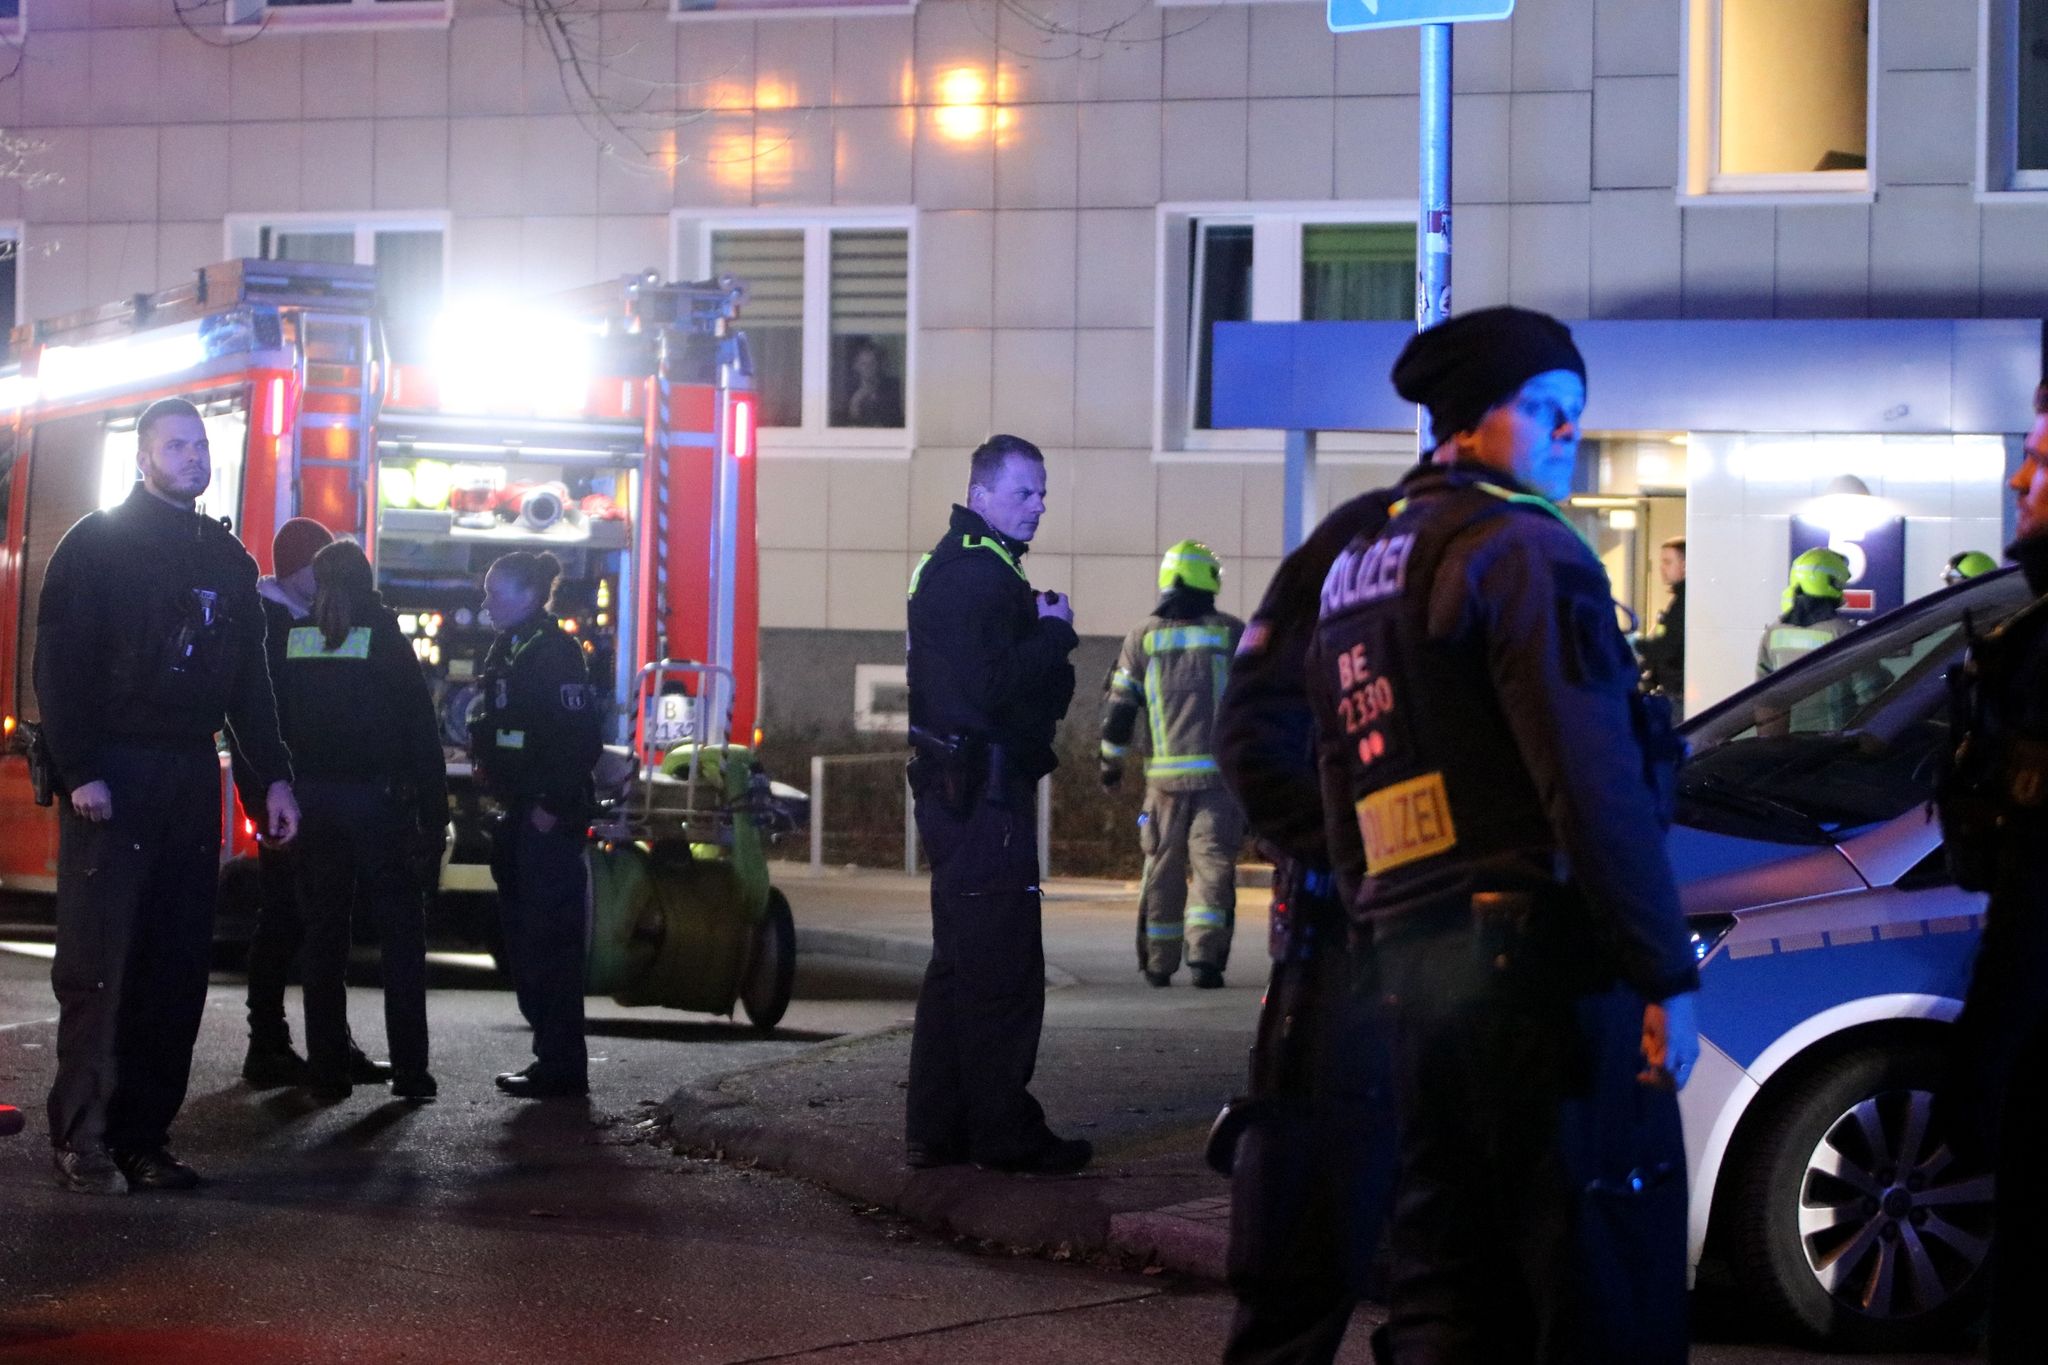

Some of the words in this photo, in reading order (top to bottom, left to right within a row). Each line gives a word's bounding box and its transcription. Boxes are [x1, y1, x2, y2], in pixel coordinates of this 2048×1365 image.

[1828, 525, 1867, 585] 5
[1338, 642, 1371, 690] BE
[664, 700, 677, 720] B
[1338, 676, 1395, 734] 2330
